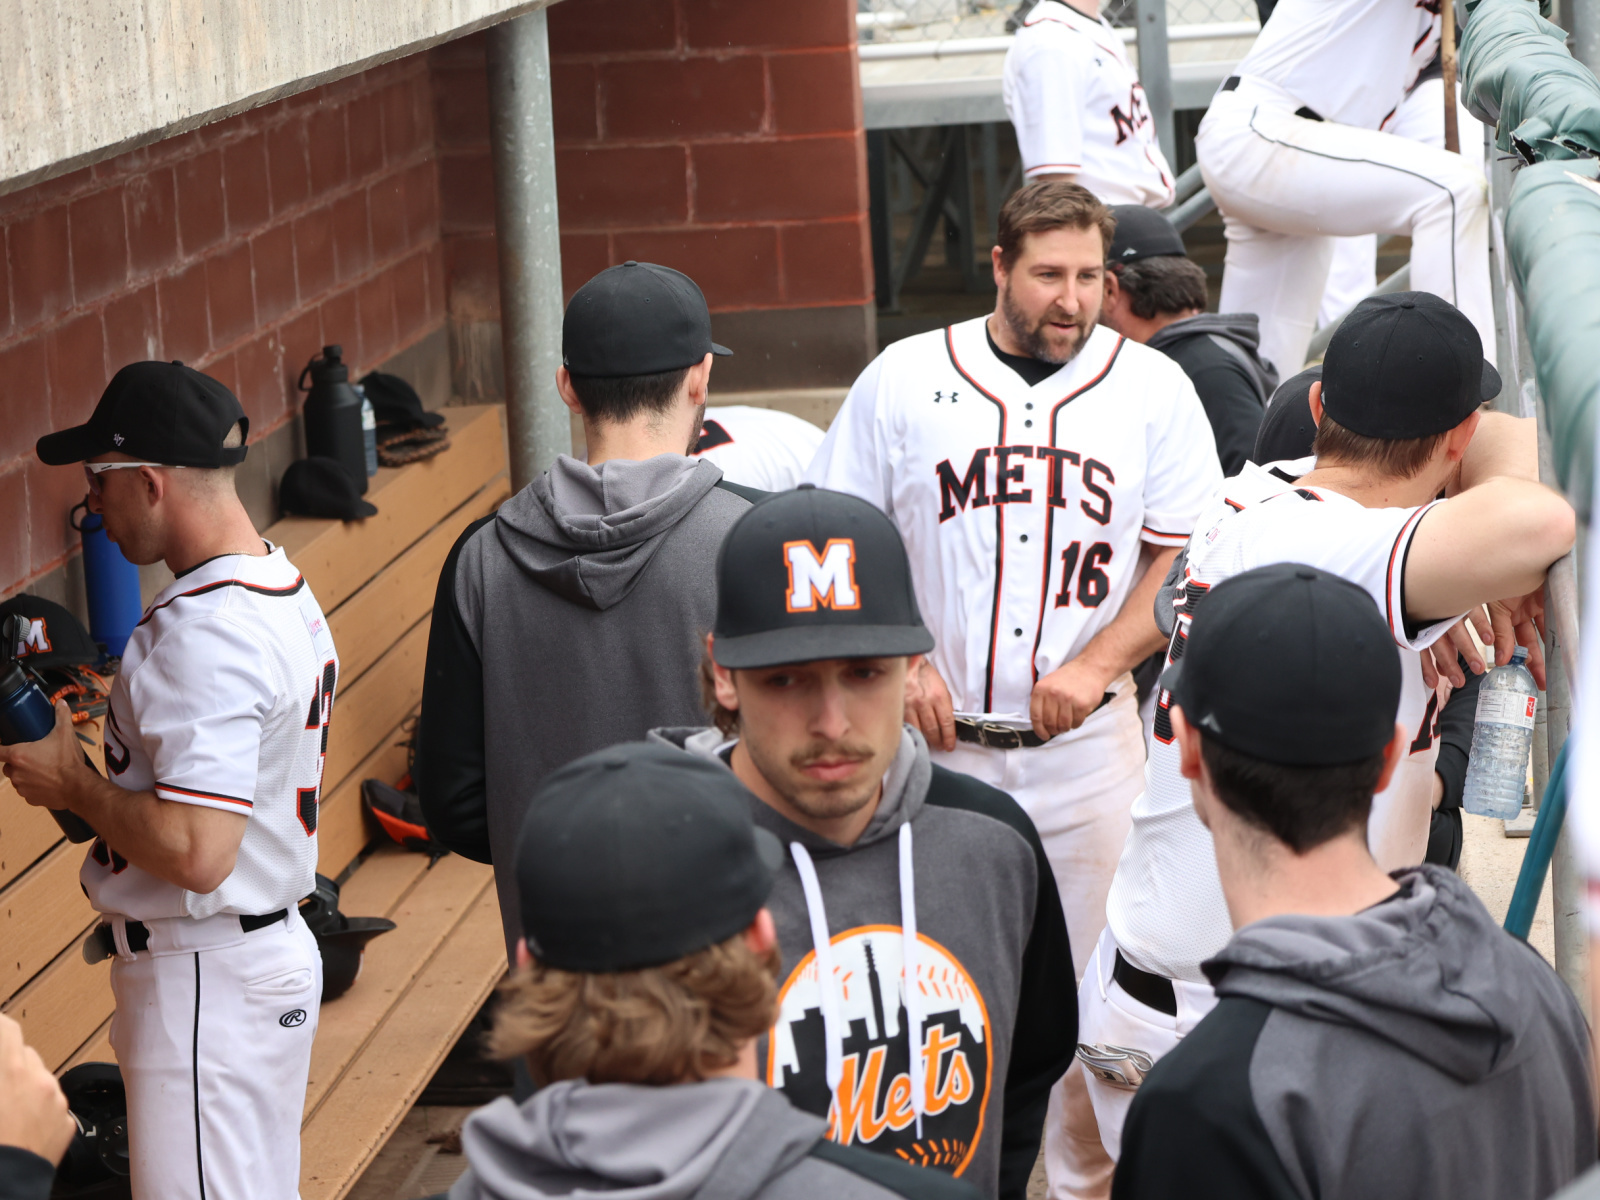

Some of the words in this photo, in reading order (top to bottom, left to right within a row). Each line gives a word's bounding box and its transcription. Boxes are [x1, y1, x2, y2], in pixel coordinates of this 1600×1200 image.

[935, 445, 1116, 527] METS
[783, 538, 862, 613] M
[1054, 540, 1114, 610] 16
[16, 617, 53, 659] M
[823, 1023, 975, 1147] Mets
